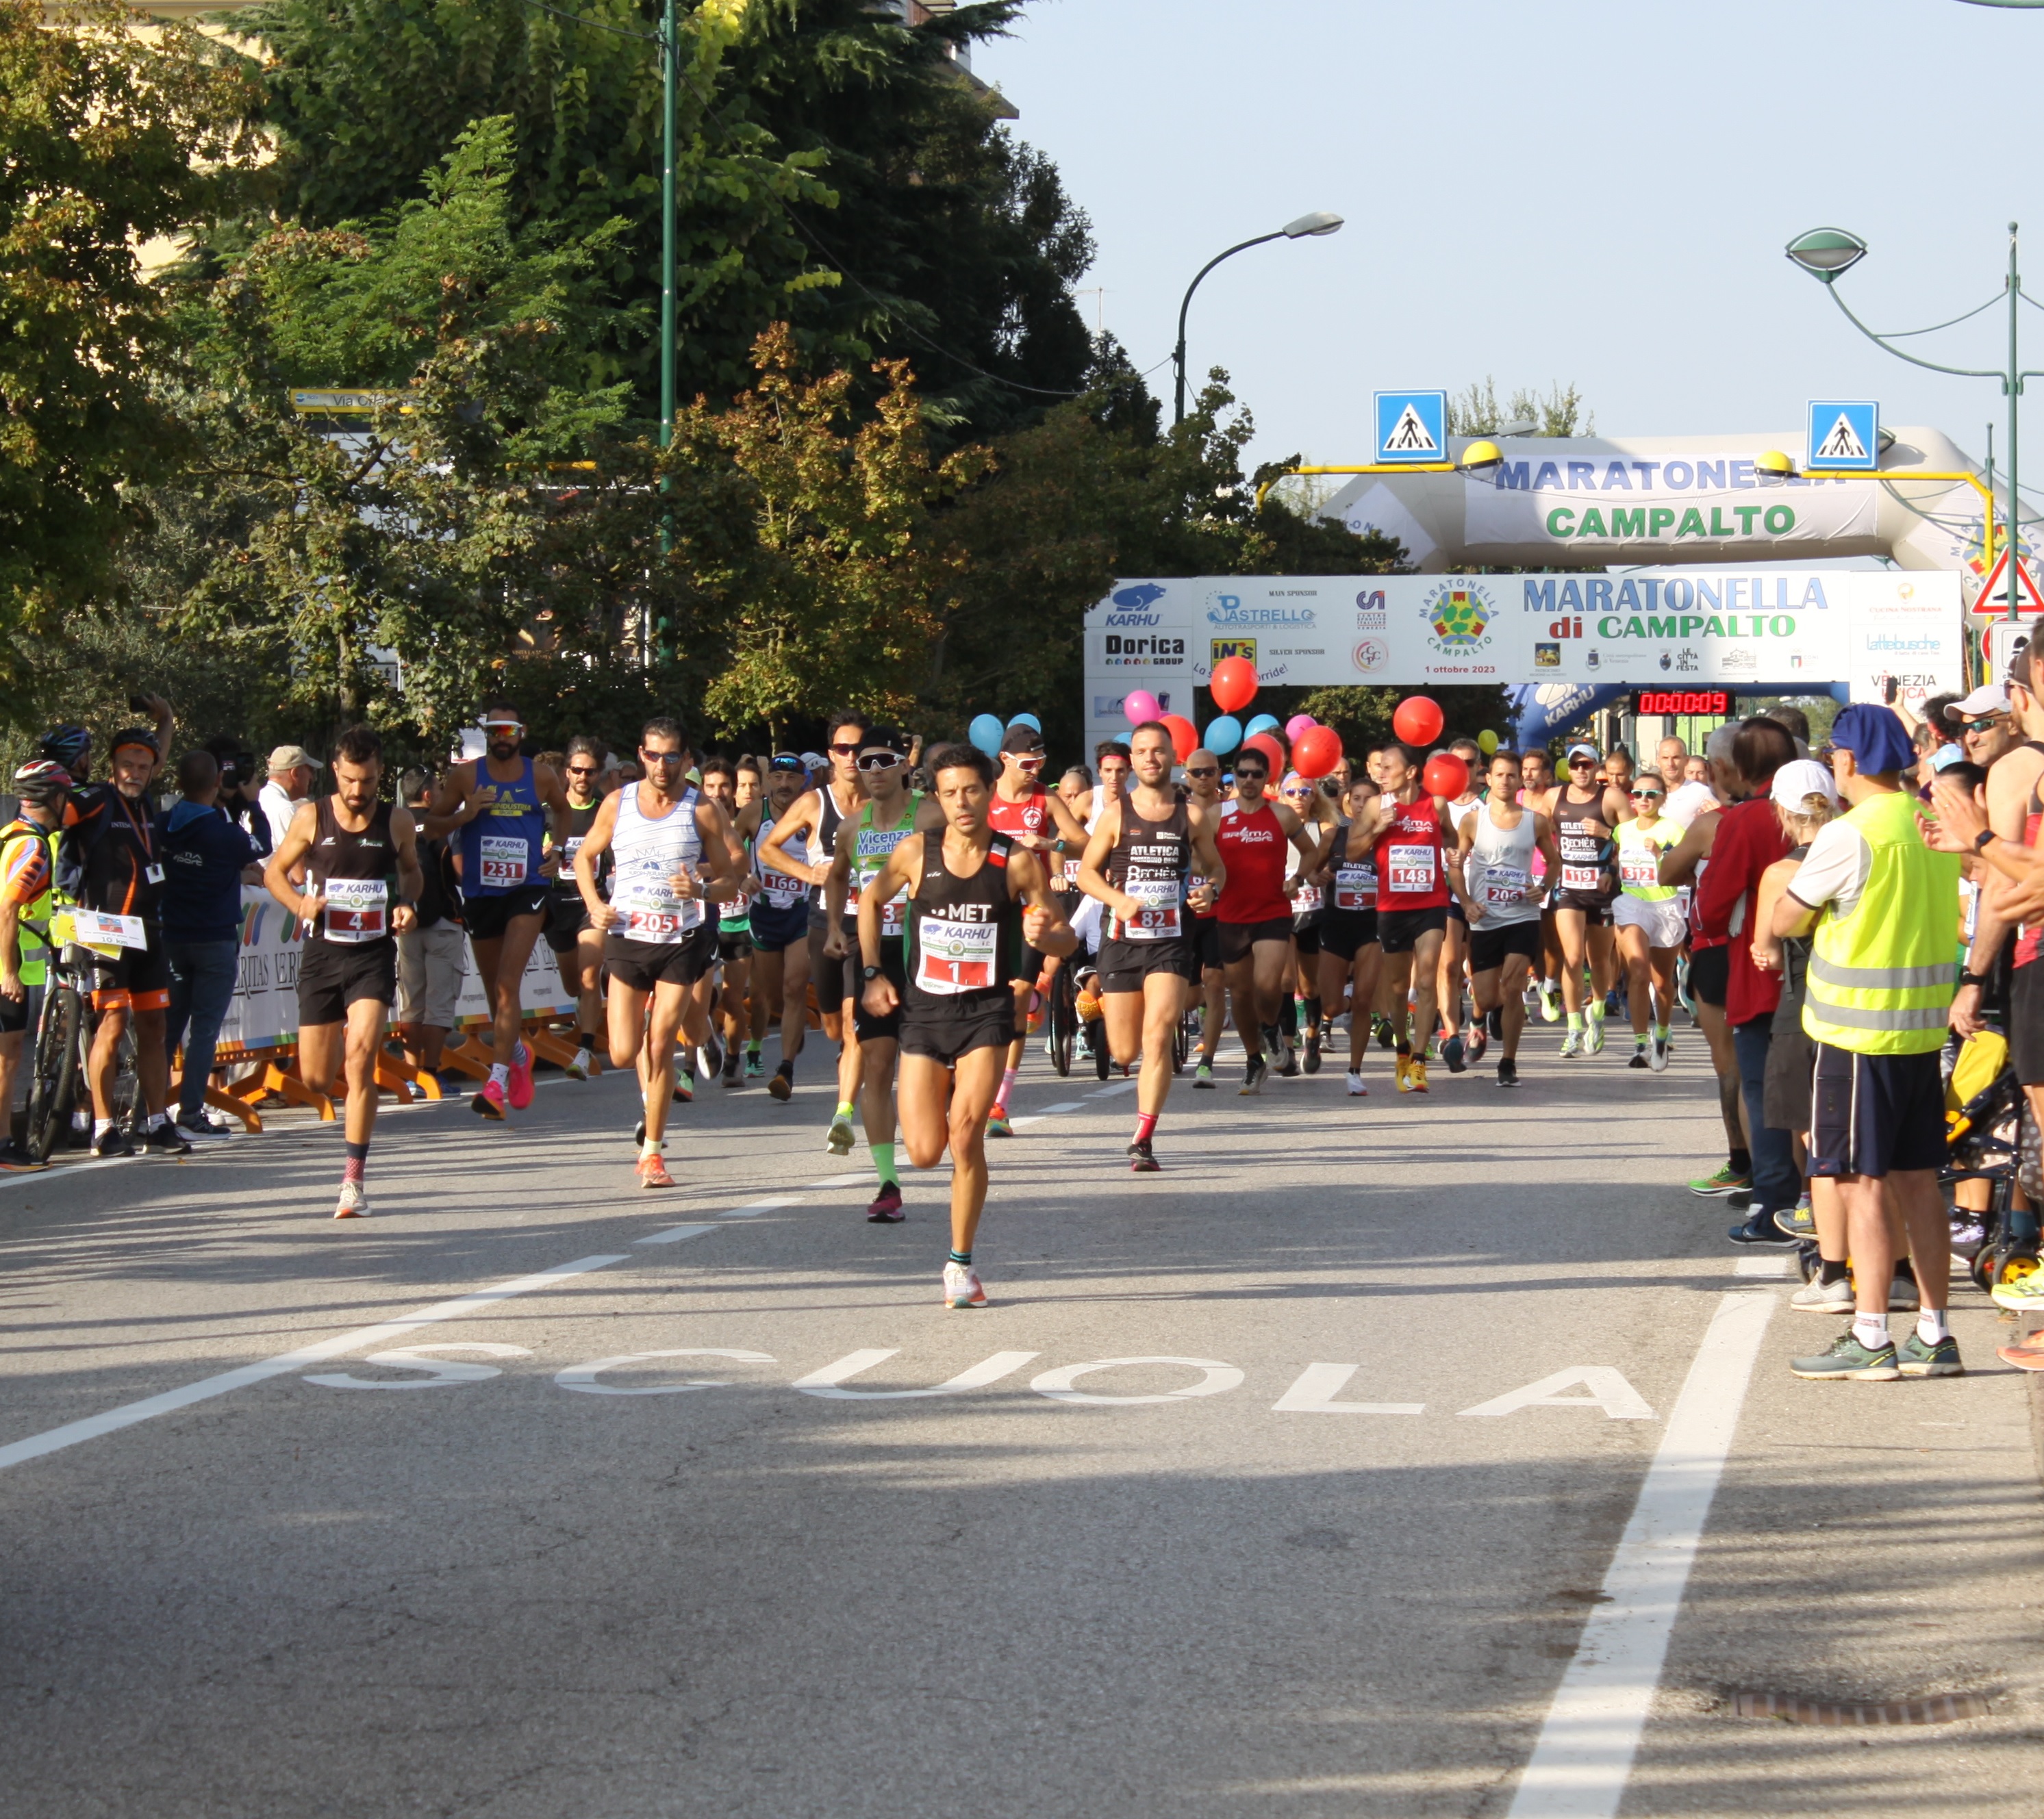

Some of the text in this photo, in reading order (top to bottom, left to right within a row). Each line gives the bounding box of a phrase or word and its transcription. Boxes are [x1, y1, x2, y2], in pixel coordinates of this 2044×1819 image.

[333, 395, 353, 406] Via
[1546, 504, 1795, 538] CAMPALTO
[1419, 578, 1500, 618] MARATONELLA
[1524, 577, 1828, 612] MARATONELLA
[1106, 614, 1159, 626] KARHU
[1550, 615, 1795, 639] di CAMPALTO
[1106, 635, 1184, 654] Dorica
[1427, 636, 1491, 657] CAMPALTO
[1194, 663, 1206, 676] La
[1257, 663, 1289, 683] orride!
[1544, 685, 1595, 726] KARHU
[1641, 694, 1727, 713] 00:00:09
[495, 840, 525, 849] KARHU
[858, 829, 913, 845] Vicenza
[1131, 845, 1179, 856] ATLETICA
[488, 863, 516, 877] 231
[1342, 863, 1372, 872] ATLETICA
[1398, 869, 1427, 882] 148
[1626, 868, 1650, 880] 312
[770, 876, 798, 891] 166
[1569, 871, 1592, 882] 119
[346, 884, 383, 893] KARHU
[647, 888, 672, 898] KARH
[1144, 885, 1176, 893] KARHU
[1491, 889, 1519, 902] 206
[1354, 893, 1363, 906] 5
[883, 905, 895, 923] 3
[948, 904, 992, 922] MET
[1141, 911, 1165, 928] 82
[349, 913, 363, 930] 4
[635, 913, 674, 932] 205
[944, 926, 992, 939] KARHU
[234, 954, 269, 1000] RITAS
[948, 962, 959, 984] 1
[303, 1343, 1654, 1421] SCUOLA
